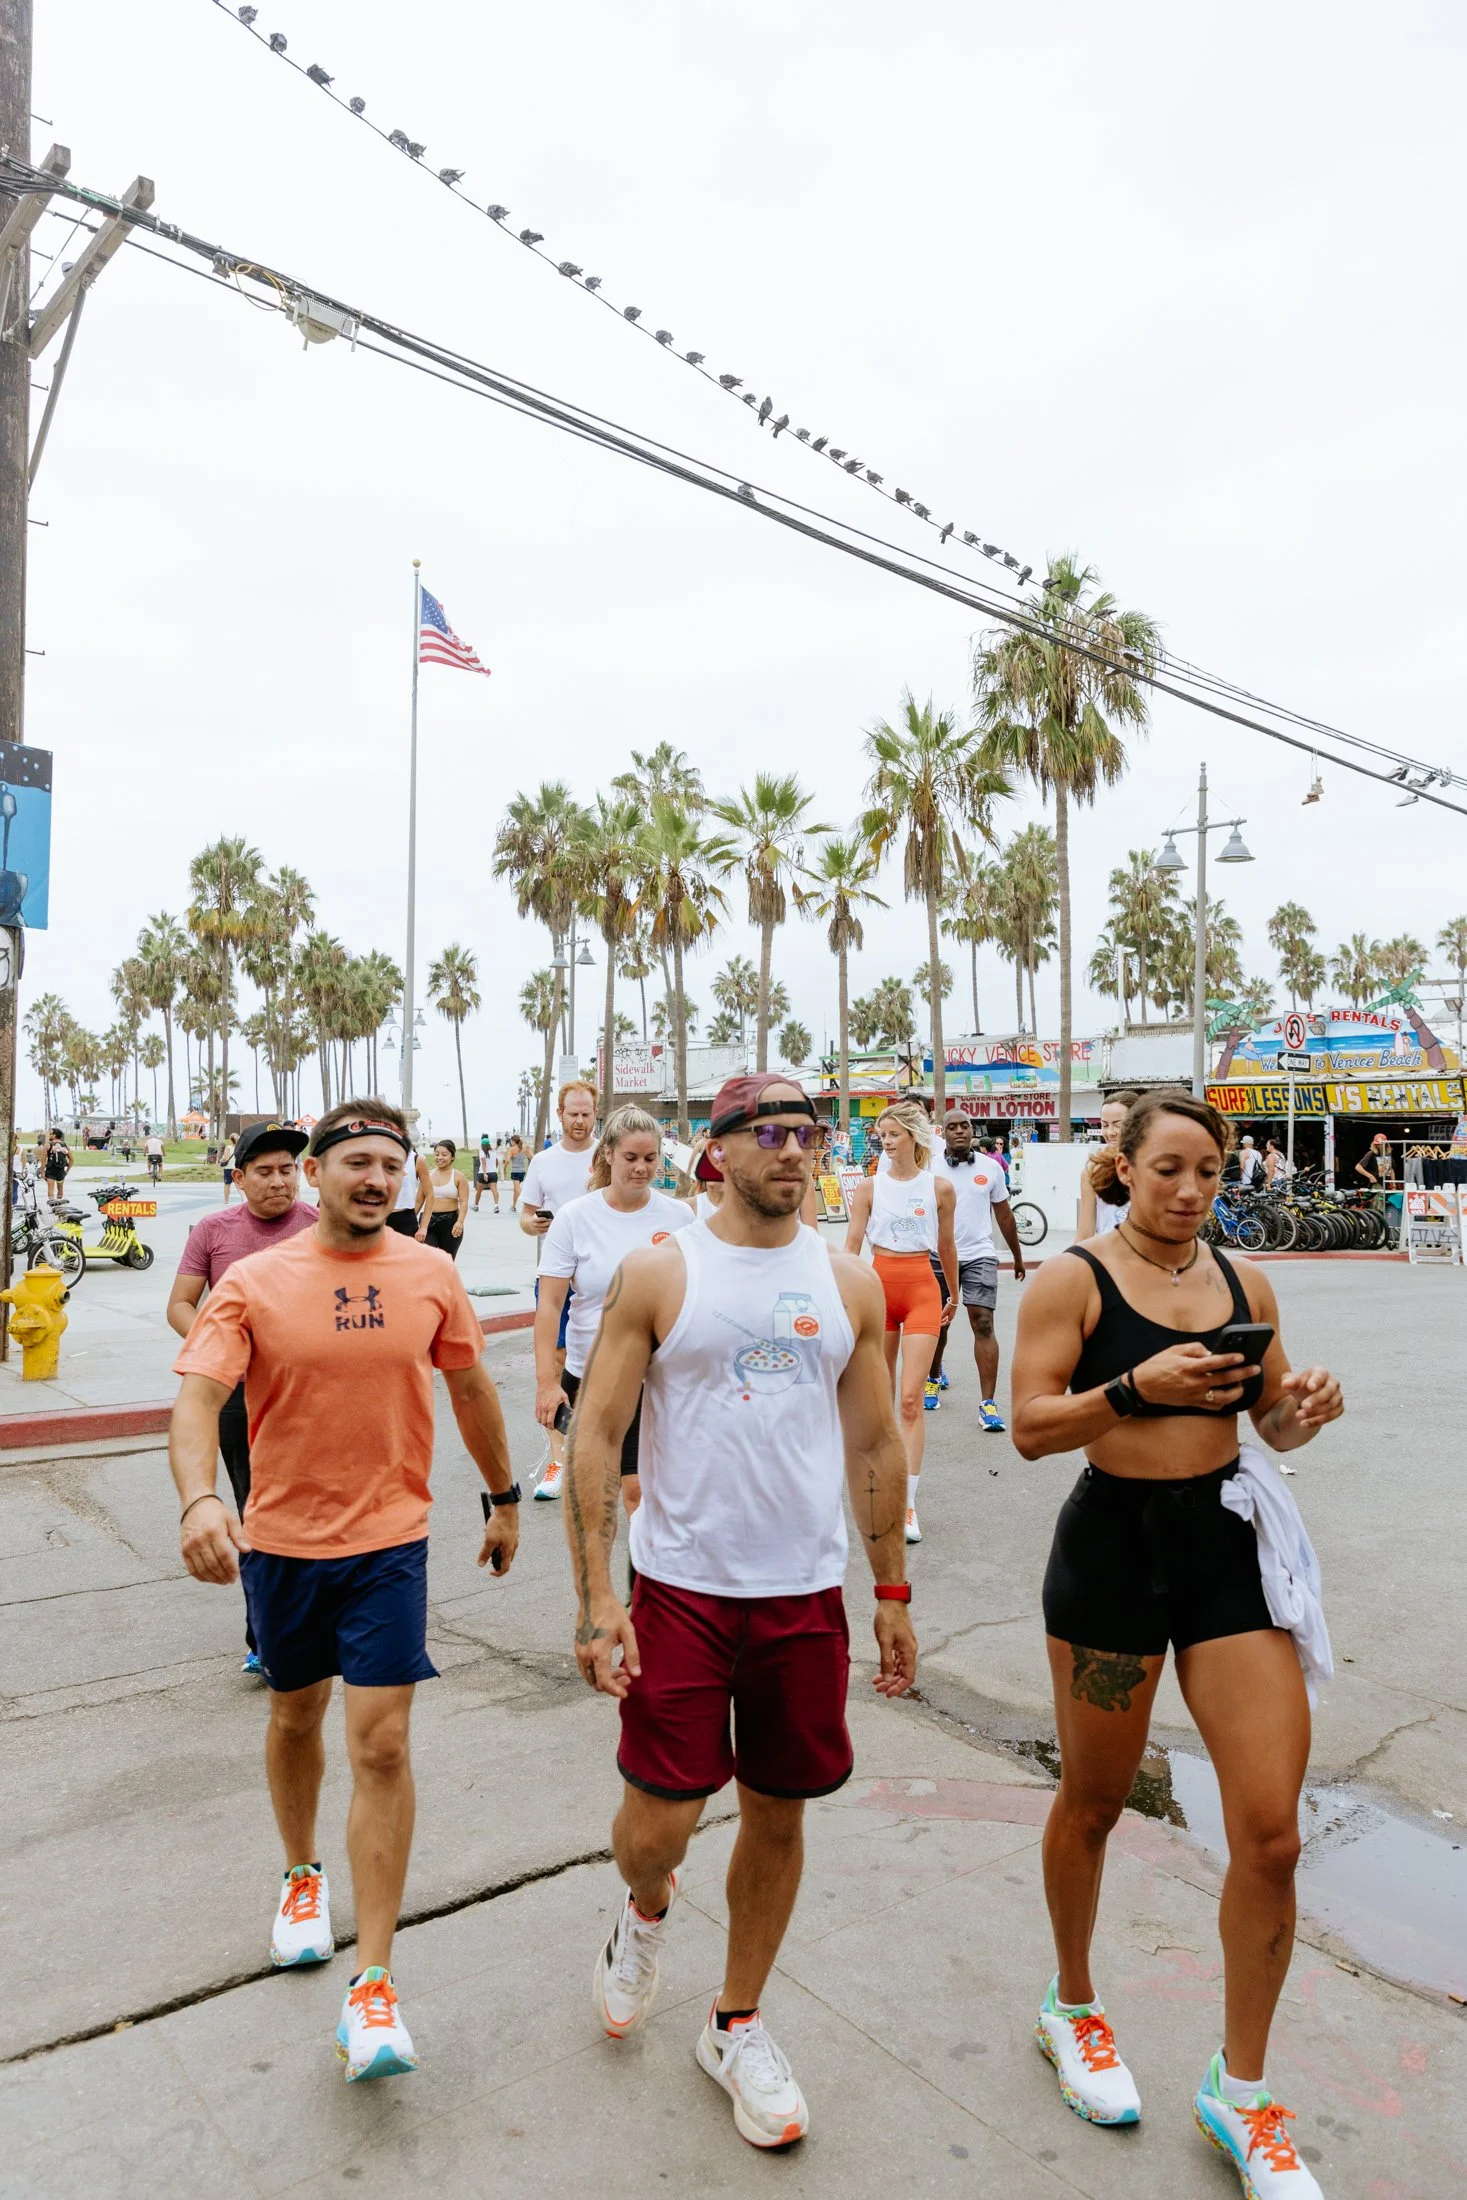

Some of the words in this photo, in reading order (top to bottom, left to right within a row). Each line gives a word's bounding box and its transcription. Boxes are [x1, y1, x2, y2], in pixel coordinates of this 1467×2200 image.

[1331, 1011, 1401, 1031] RENTALS
[943, 1047, 976, 1066] UCKY
[986, 1043, 1036, 1064] VENICE
[1043, 1041, 1091, 1061] STRE
[1315, 1056, 1325, 1069] to
[1329, 1052, 1373, 1069] Venice
[1378, 1050, 1422, 1067] Beach
[615, 1062, 655, 1075] Sidewalk
[1287, 1058, 1296, 1066] ONE
[1298, 1059, 1308, 1067] WAY
[615, 1076, 647, 1087] Market
[1024, 1092, 1050, 1100] STORE
[1207, 1088, 1246, 1111] SURF
[1253, 1087, 1324, 1111] LESSONS
[1330, 1083, 1362, 1110] J'S
[1367, 1082, 1464, 1110] RENTALS
[960, 1102, 990, 1117] SUN
[997, 1100, 1055, 1117] LOTION
[836, 1133, 849, 1143] EBT
[824, 1188, 839, 1198] EBT
[107, 1202, 156, 1216] RENTALS
[335, 1313, 385, 1331] RUN
